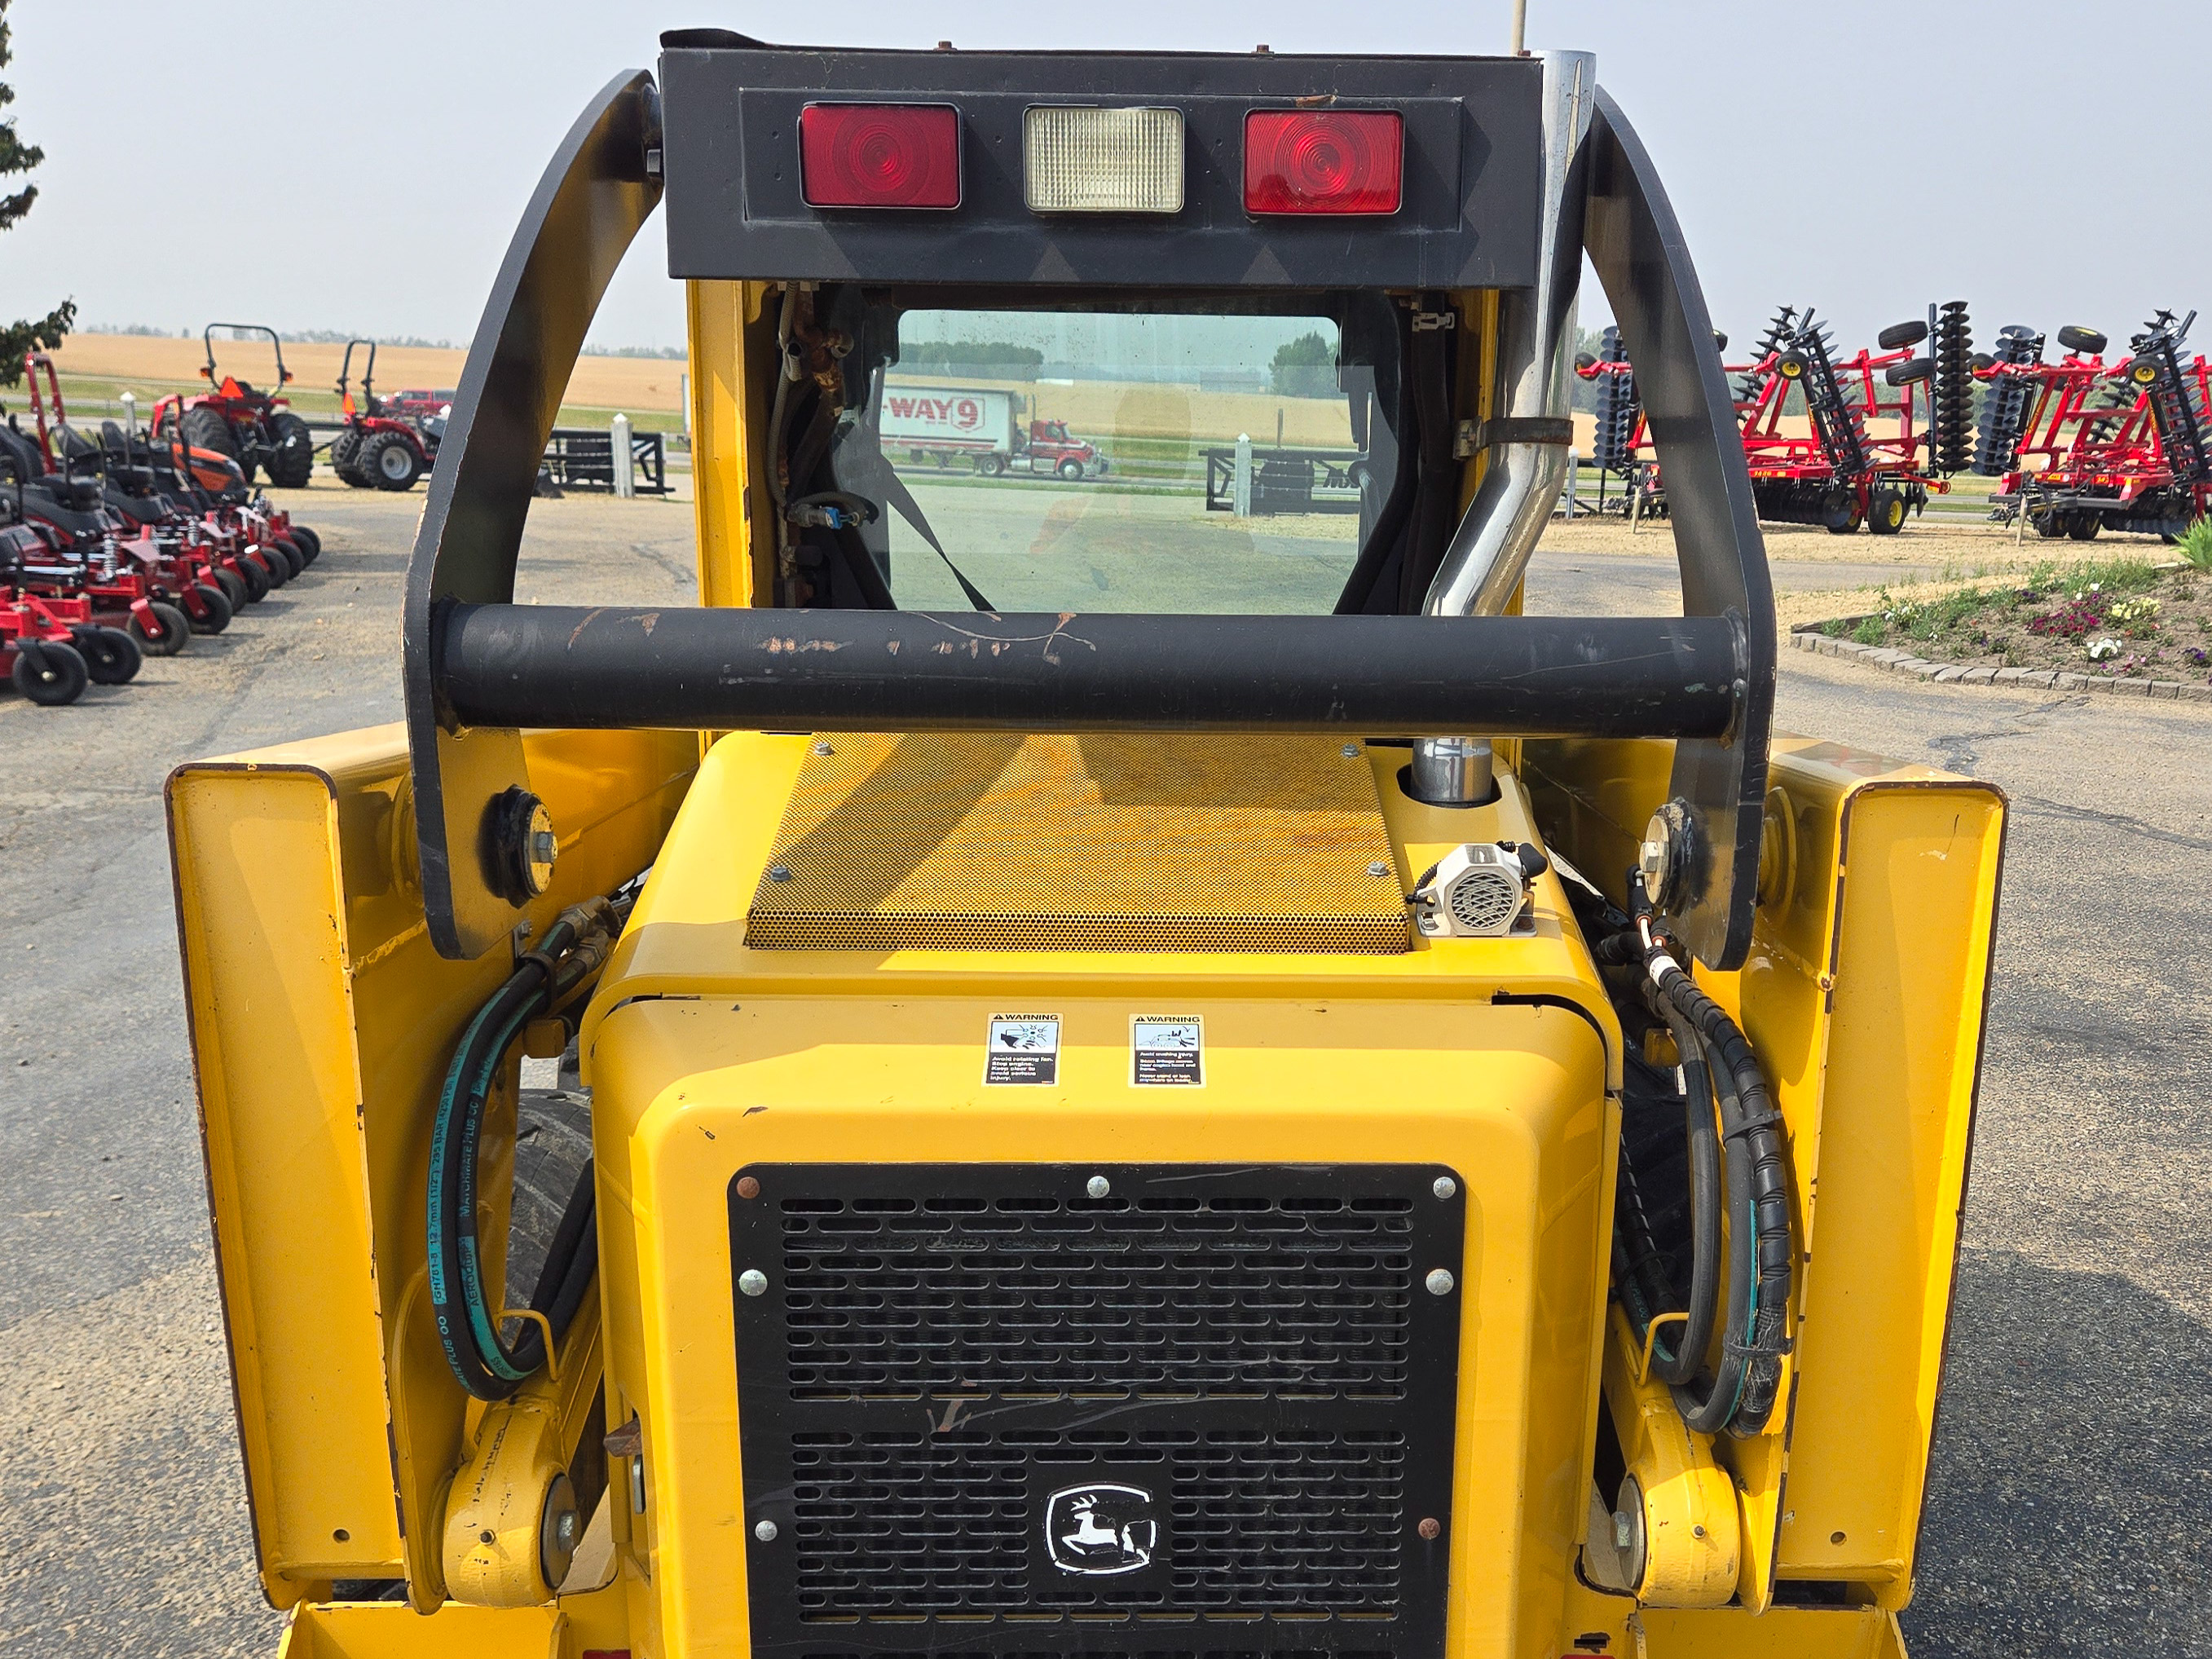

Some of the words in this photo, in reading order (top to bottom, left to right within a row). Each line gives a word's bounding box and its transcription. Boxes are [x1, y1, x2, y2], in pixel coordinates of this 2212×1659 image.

[958, 399, 978, 427] 9
[434, 1121, 443, 1144] BAR
[429, 1200, 438, 1246] 12.7mm
[443, 1339, 458, 1365] PLUS
